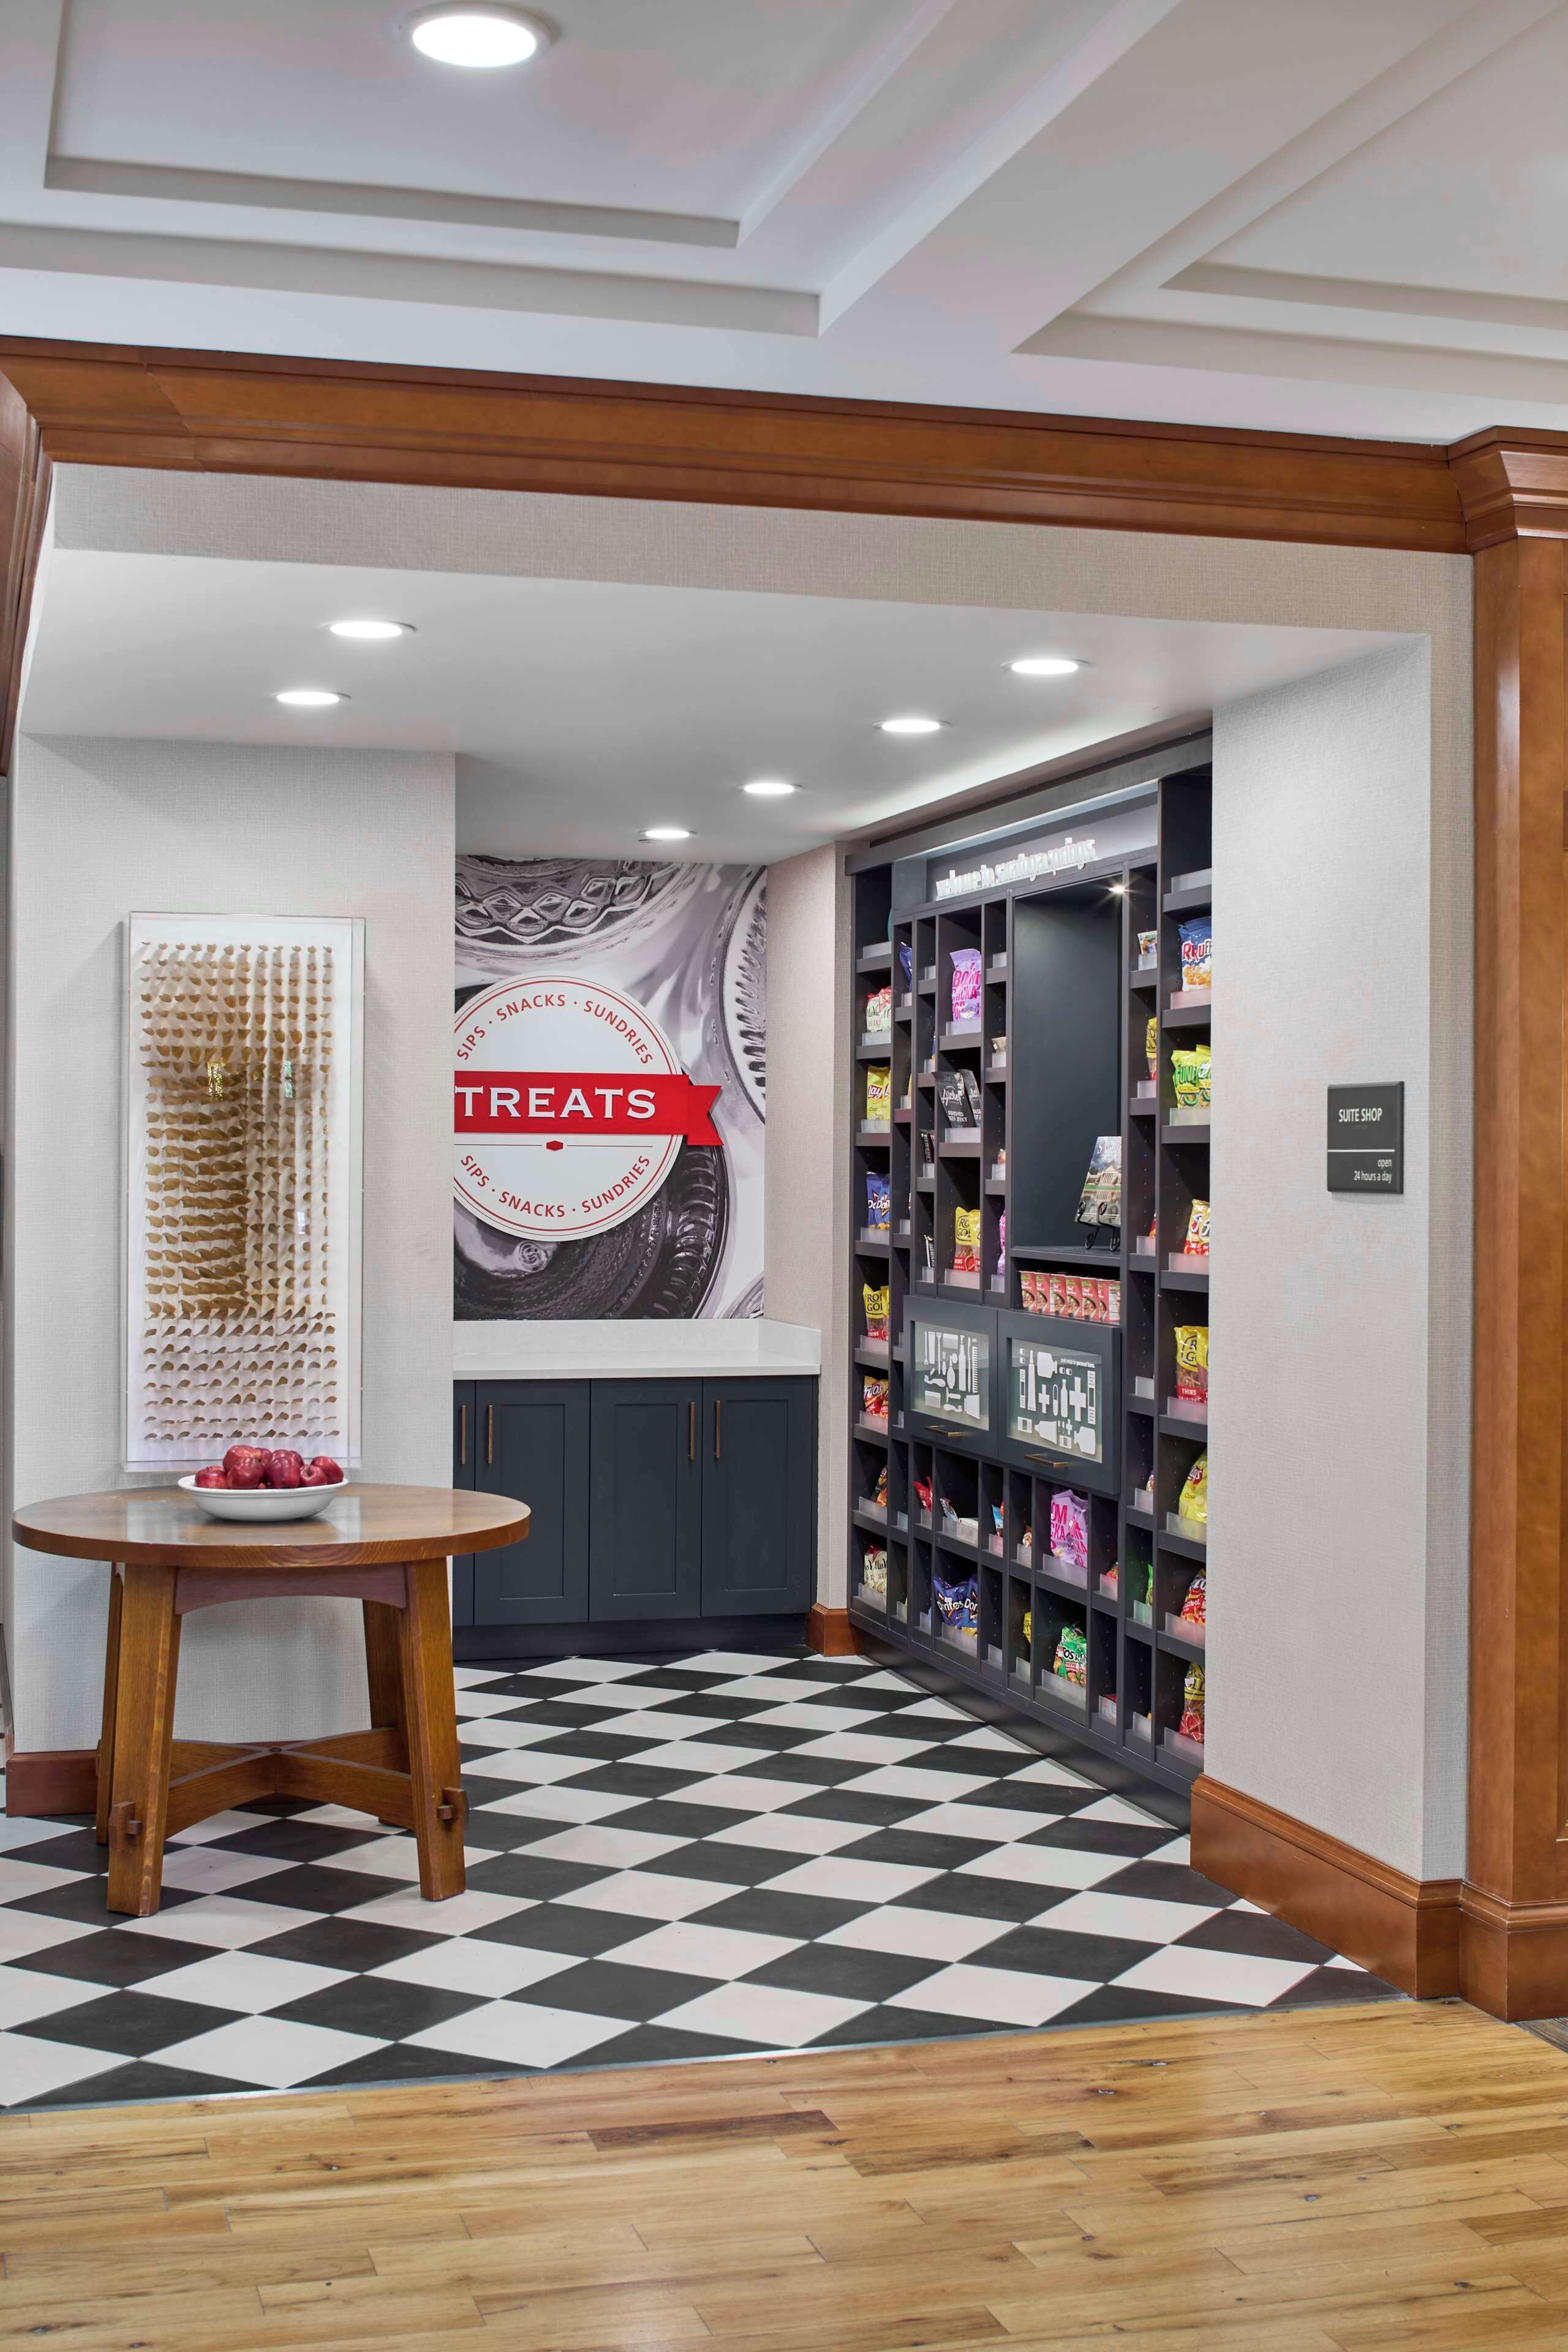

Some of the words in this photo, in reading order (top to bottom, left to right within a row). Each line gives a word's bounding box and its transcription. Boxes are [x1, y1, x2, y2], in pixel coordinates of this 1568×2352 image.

[458, 1027, 486, 1060] SIPS
[497, 994, 565, 1020] SNACKS
[583, 1000, 653, 1064] SUNDRIES
[454, 1086, 656, 1119] TREATS
[1338, 1109, 1360, 1122] SUITE
[1361, 1107, 1383, 1121] SHOP
[1378, 1159, 1392, 1169] open
[461, 1156, 489, 1187] SIPS
[499, 1191, 565, 1217] SNACKS
[581, 1156, 650, 1213] SUNDRIES
[1354, 1170, 1360, 1181] 24
[1361, 1170, 1377, 1182] hours
[1382, 1170, 1392, 1184] day
